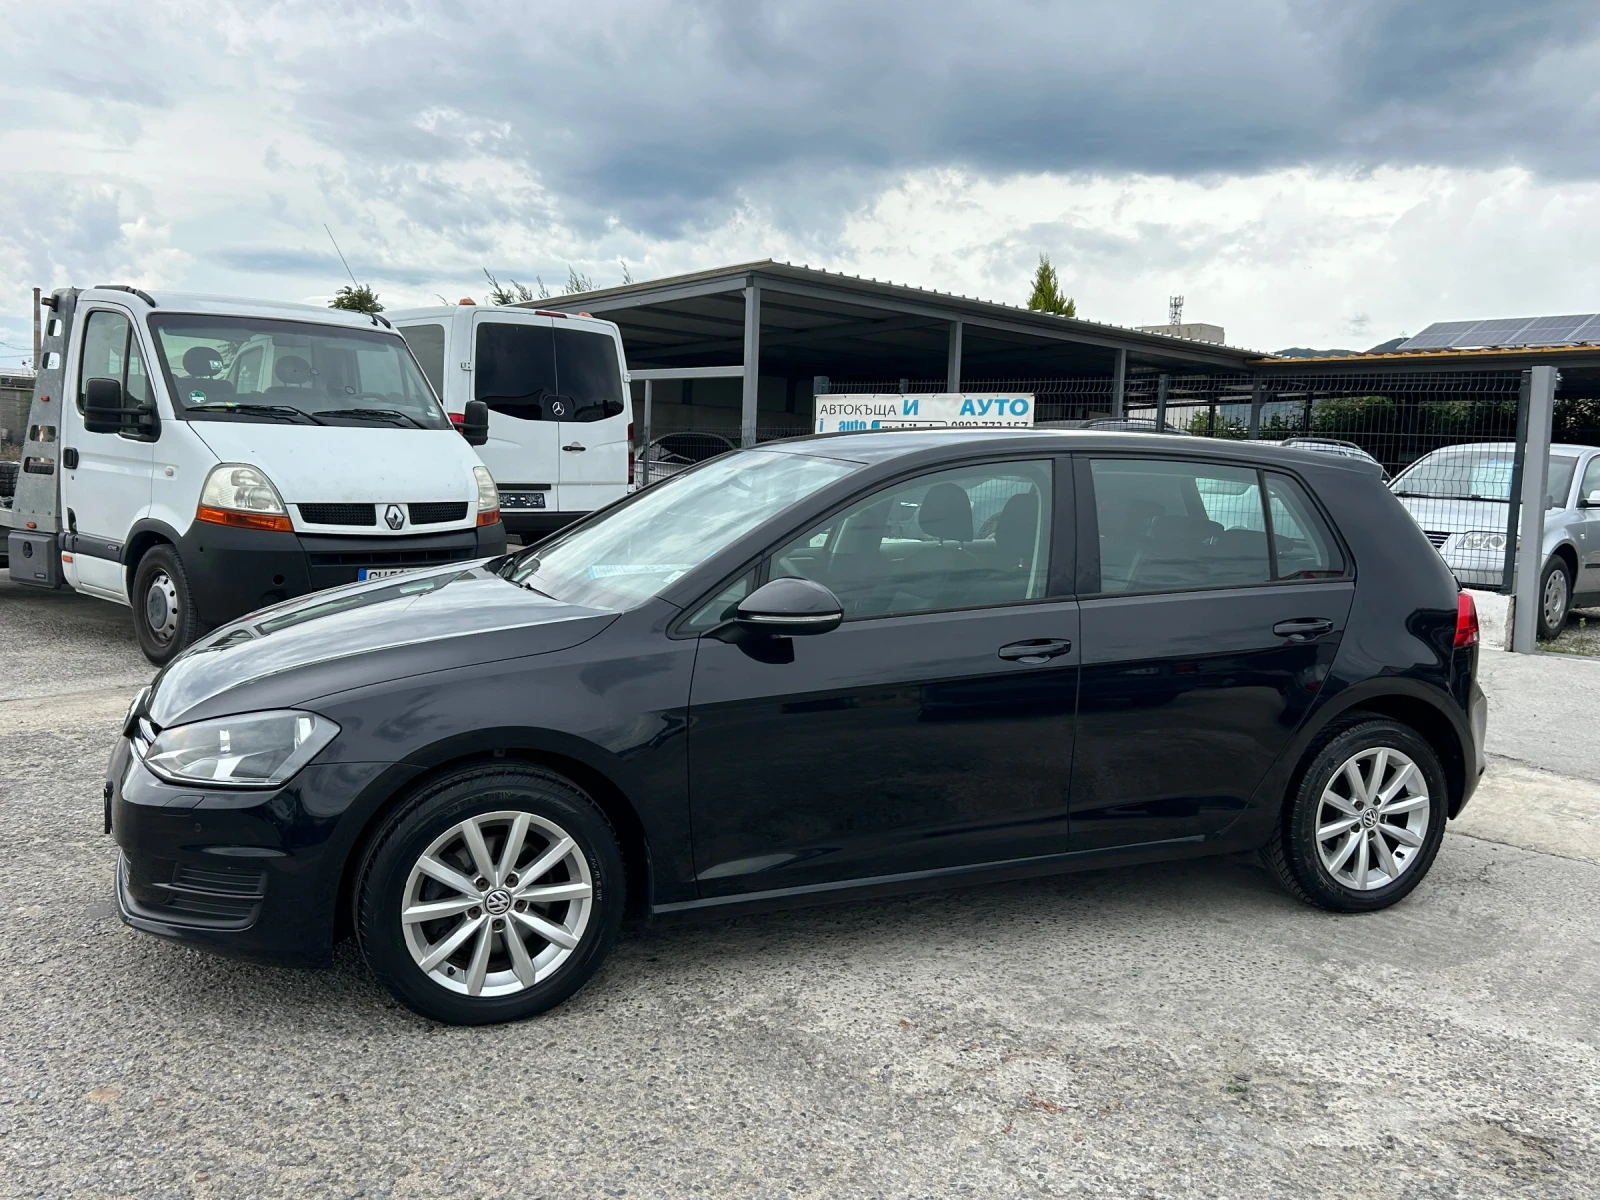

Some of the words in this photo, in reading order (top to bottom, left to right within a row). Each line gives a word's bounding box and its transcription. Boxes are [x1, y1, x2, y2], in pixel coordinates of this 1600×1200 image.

[820, 404, 897, 417] АВТОКЪЩА
[903, 399, 919, 416] И
[959, 398, 1029, 416] АУТО
[838, 420, 867, 431] auto
